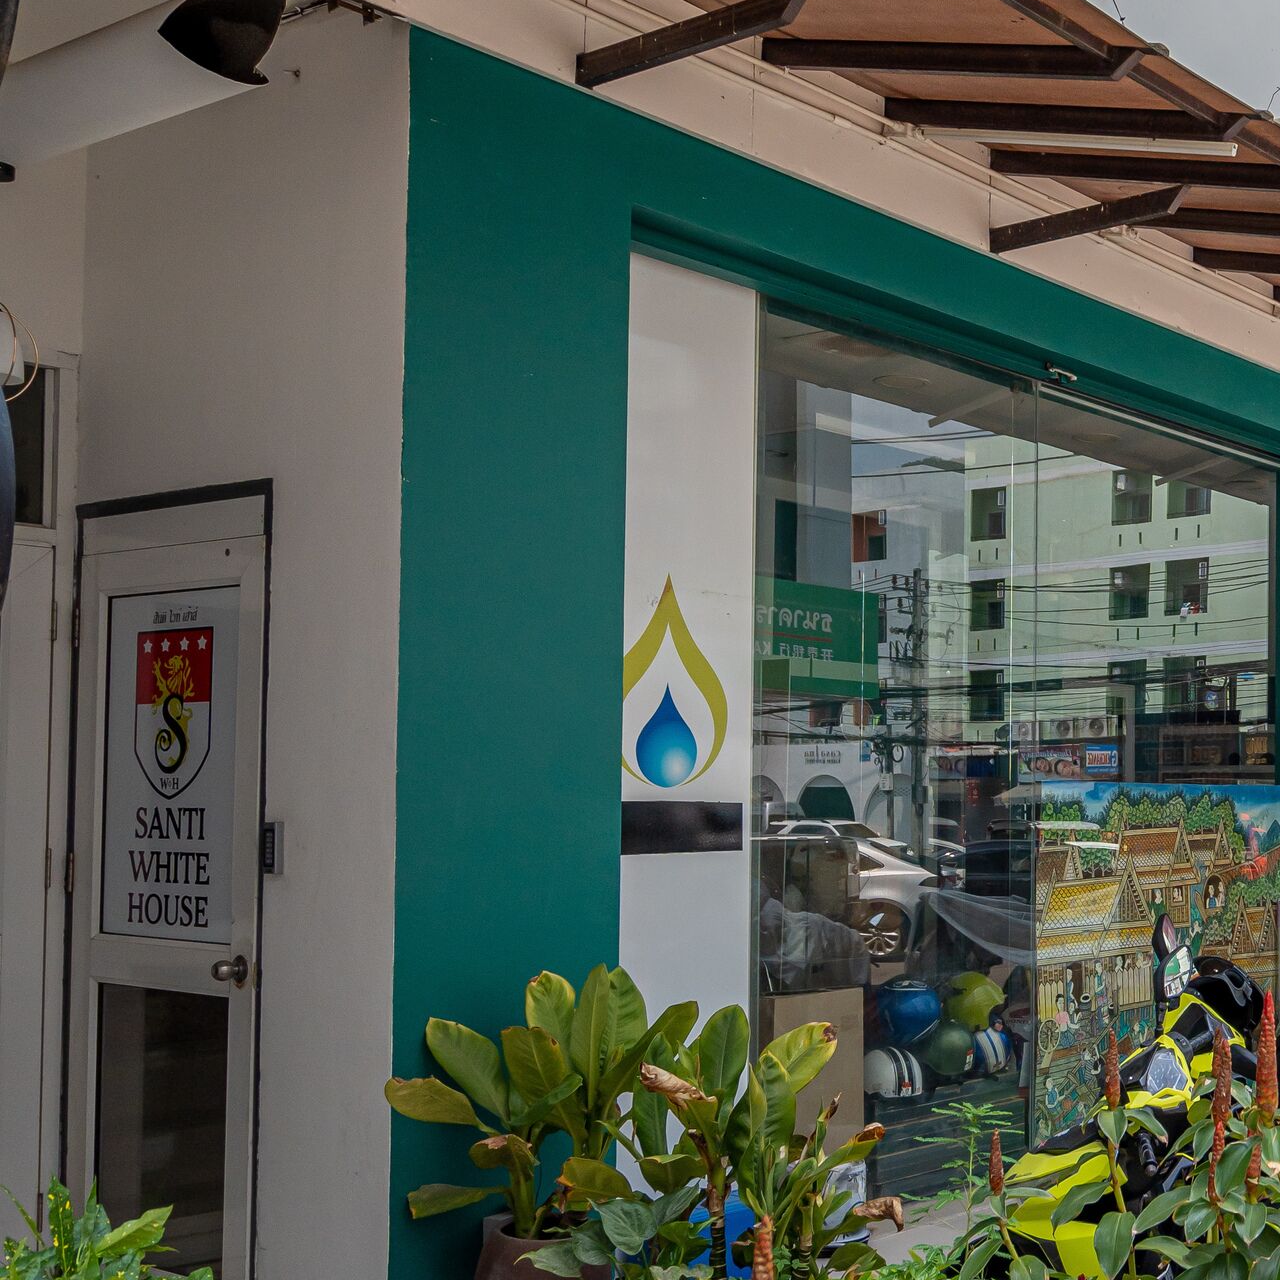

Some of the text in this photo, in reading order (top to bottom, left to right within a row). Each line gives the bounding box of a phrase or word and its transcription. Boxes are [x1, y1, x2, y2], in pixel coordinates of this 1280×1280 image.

[135, 806, 206, 841] SANTI
[128, 849, 211, 886] WHITE
[127, 892, 209, 928] HOUSE
